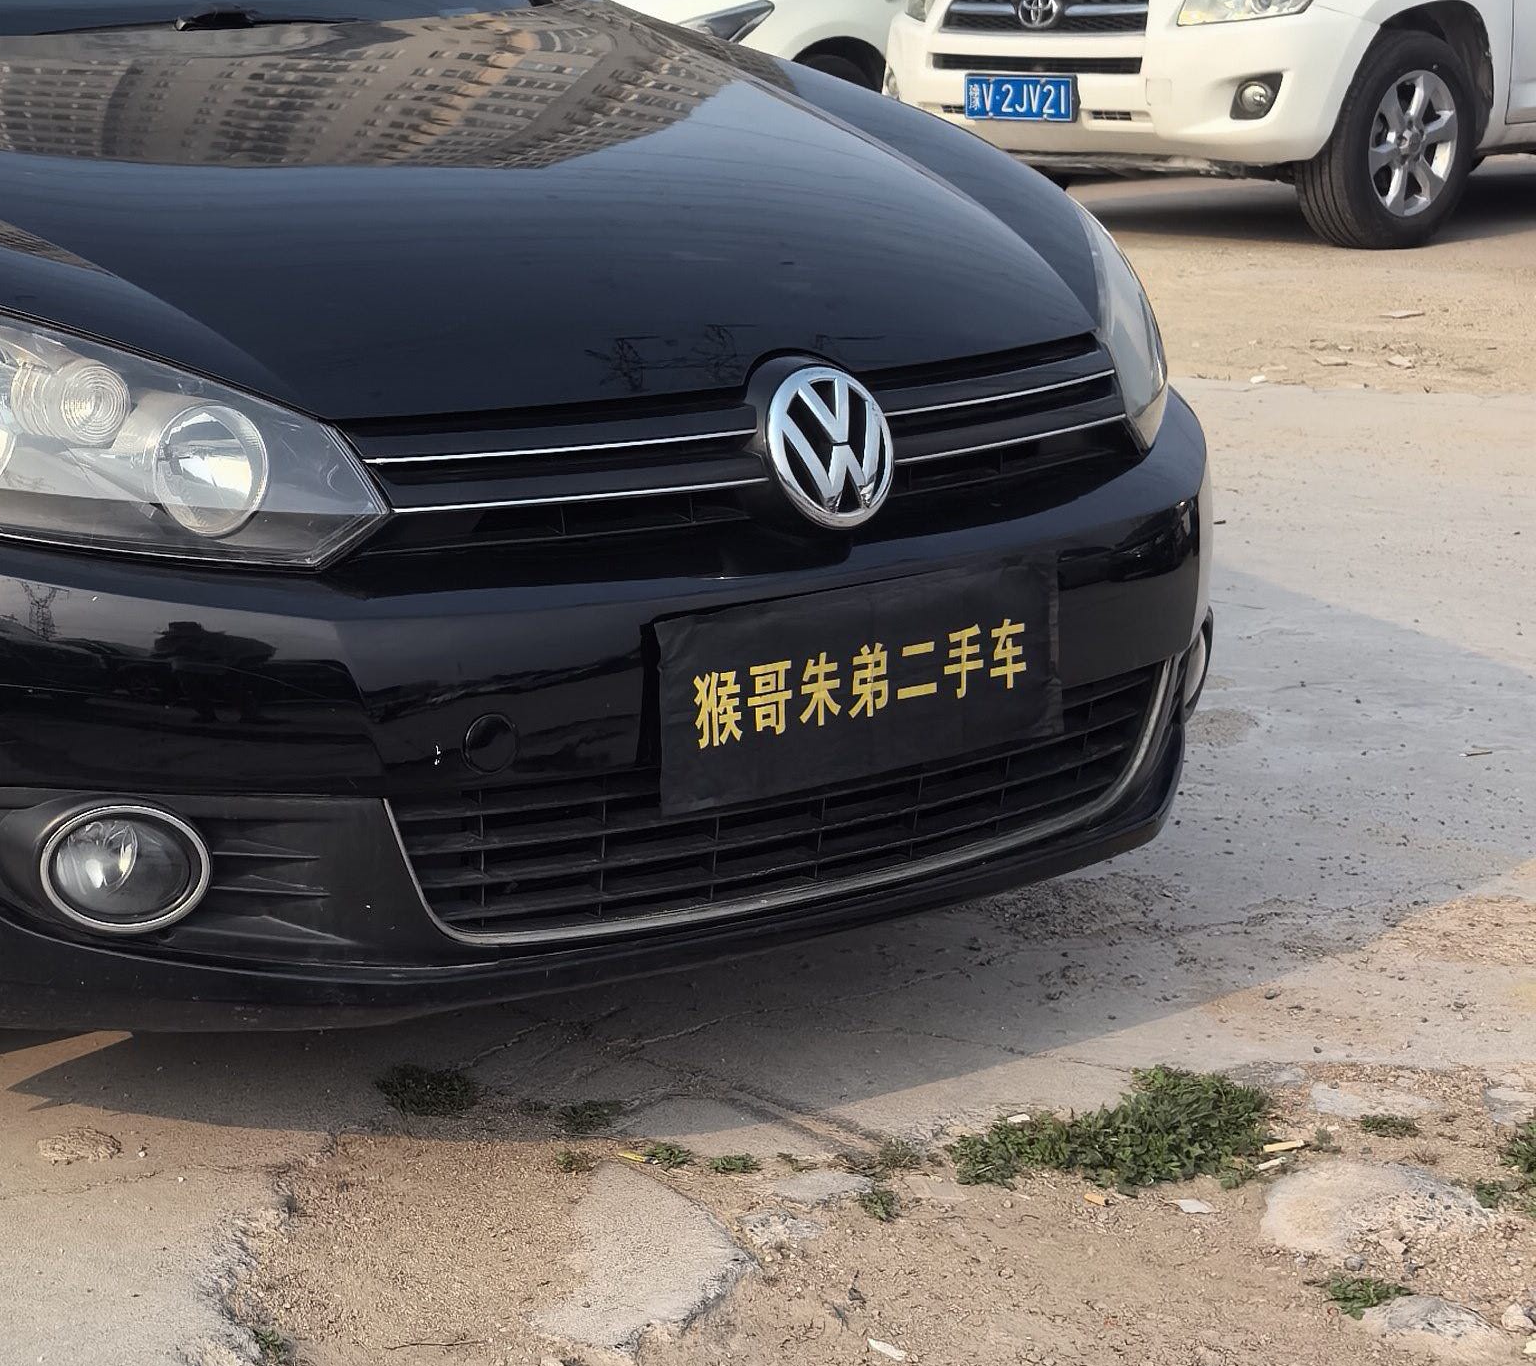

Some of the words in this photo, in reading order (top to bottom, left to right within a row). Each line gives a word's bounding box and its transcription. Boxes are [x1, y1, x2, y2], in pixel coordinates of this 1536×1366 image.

[693, 619, 1026, 749] 猴哥朱弟二手车
